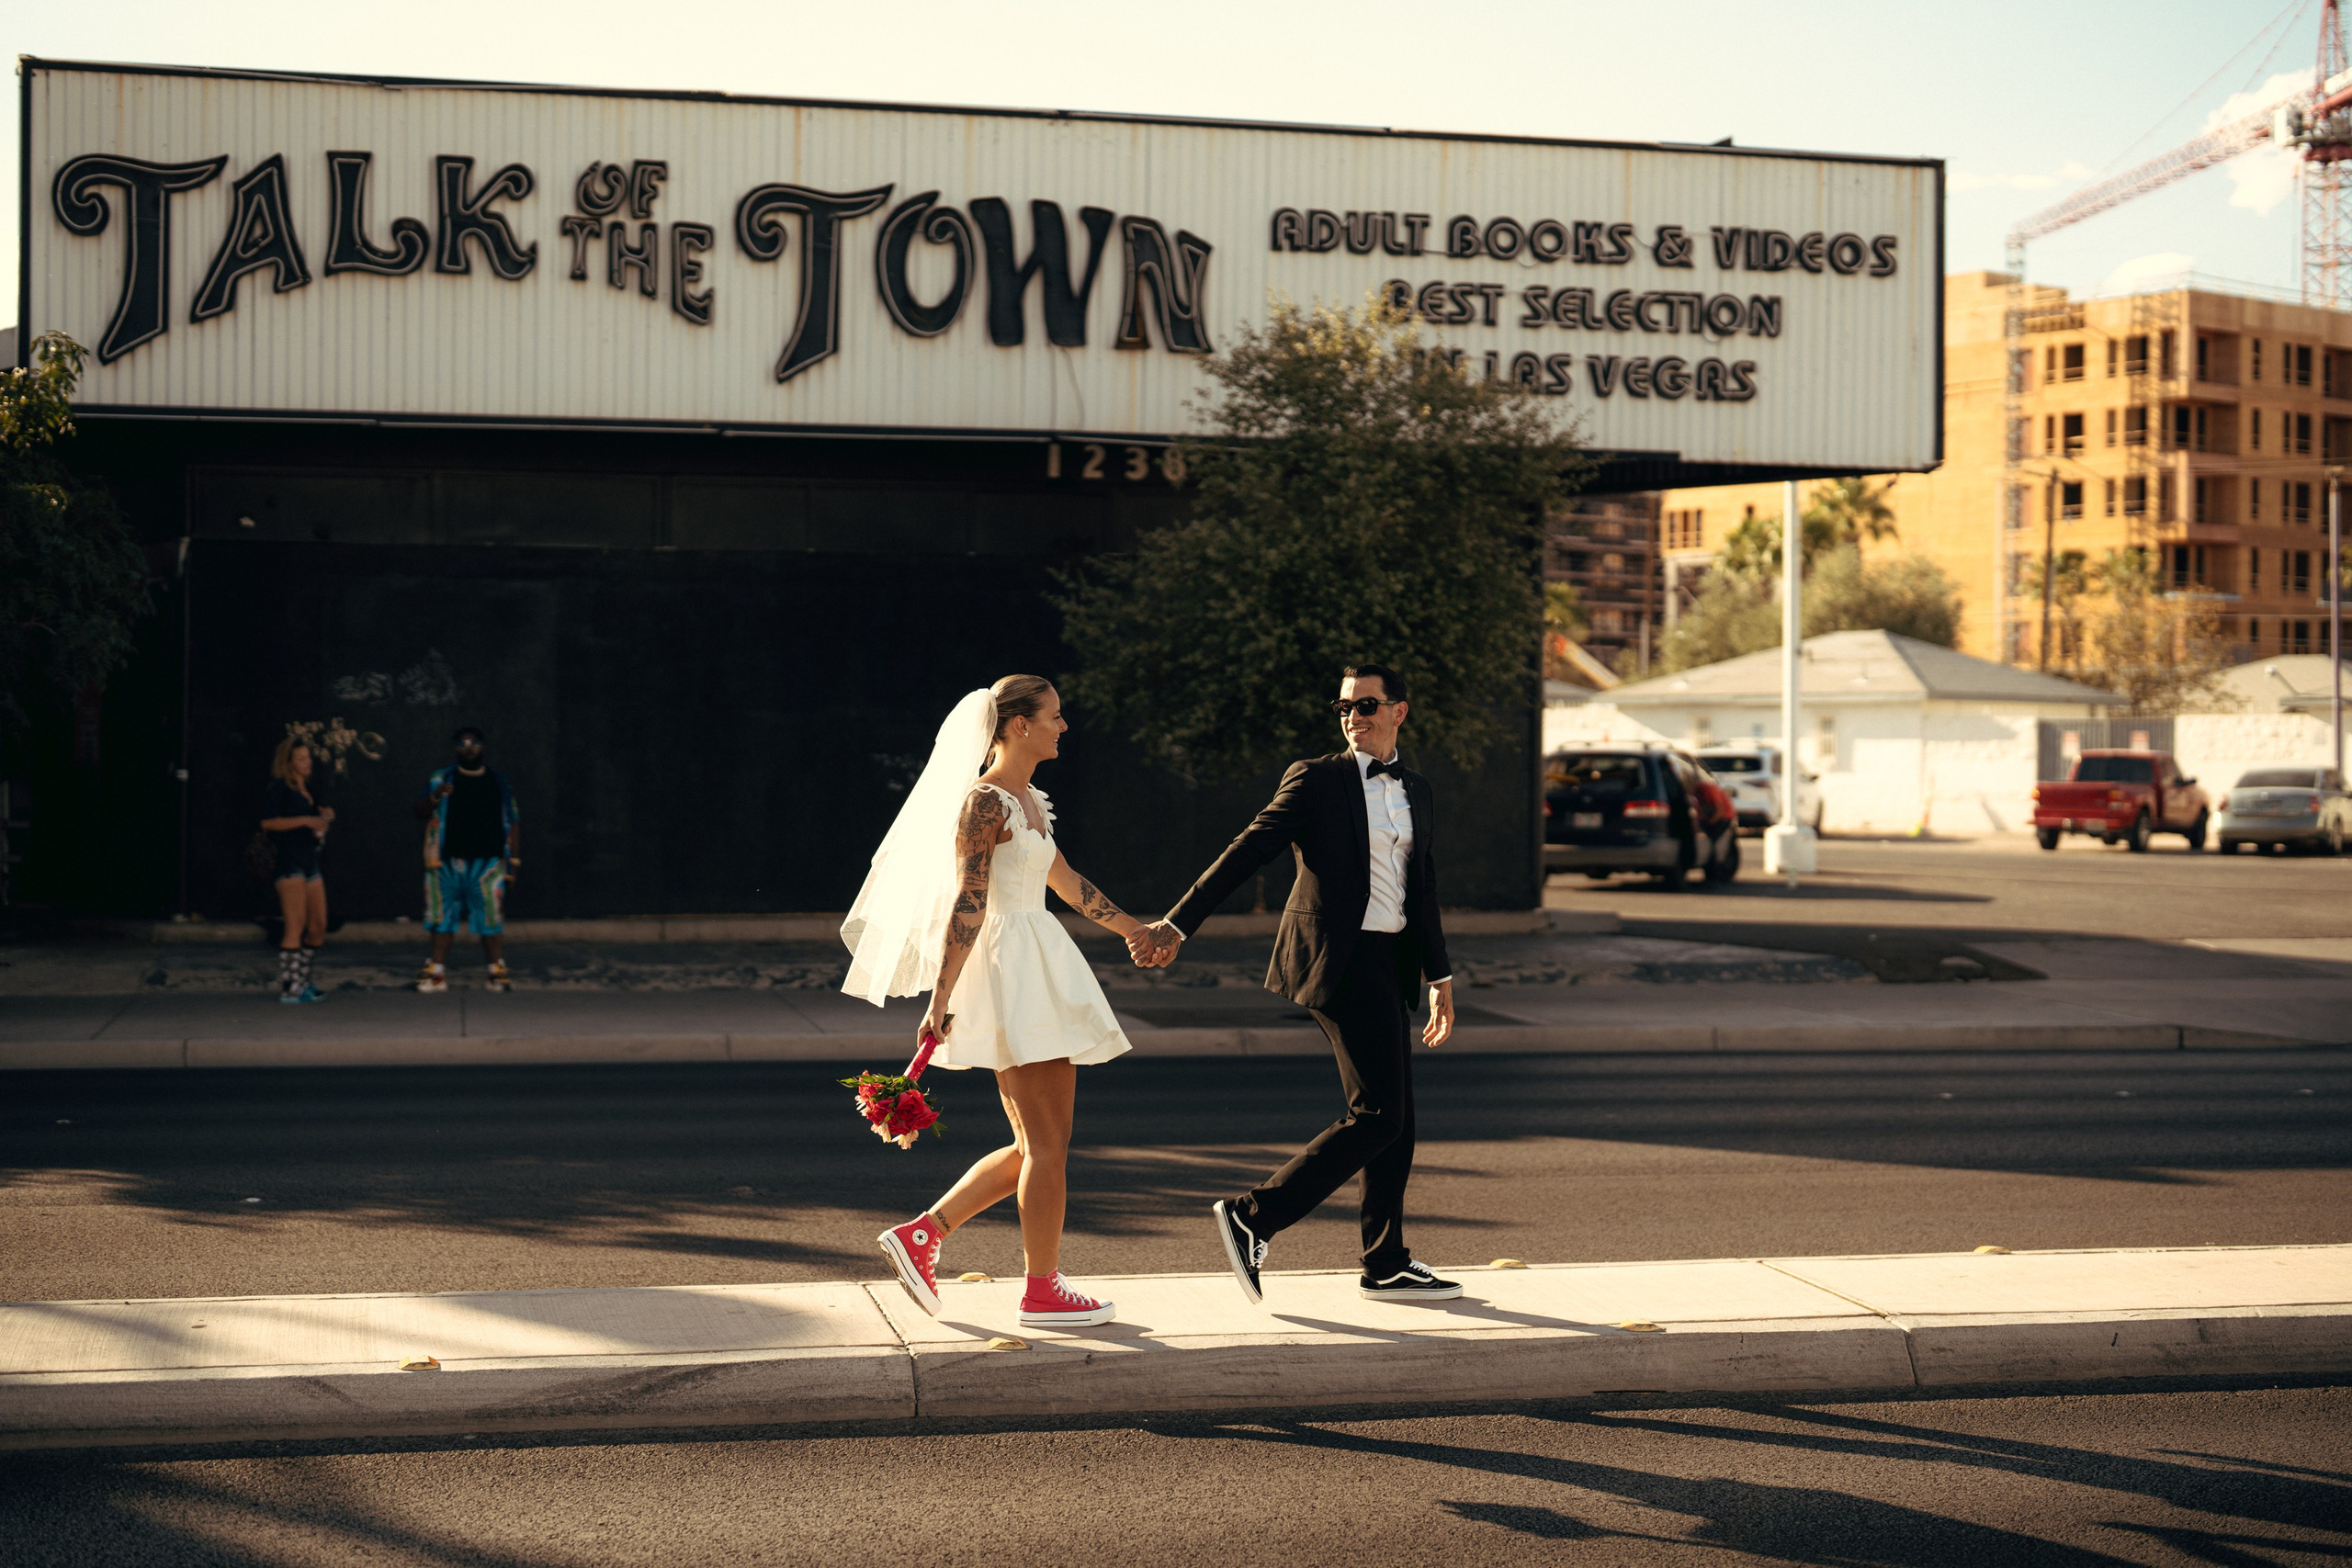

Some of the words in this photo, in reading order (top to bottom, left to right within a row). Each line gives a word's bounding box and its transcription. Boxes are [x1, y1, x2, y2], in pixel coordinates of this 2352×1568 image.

[576, 160, 667, 220] OF
[51, 151, 538, 366] TALK
[560, 215, 714, 325] THE
[1272, 208, 1430, 256] ADULT
[1448, 214, 1634, 265] BOOKS
[1654, 224, 1694, 268] &
[1711, 226, 1898, 277] VIDEOS
[736, 183, 1215, 383] TOWN
[1382, 278, 1505, 327] BEST
[1521, 284, 1782, 337] SELECTION
[1586, 355, 1758, 400] VEGAS
[1047, 444, 1187, 480] 1238
